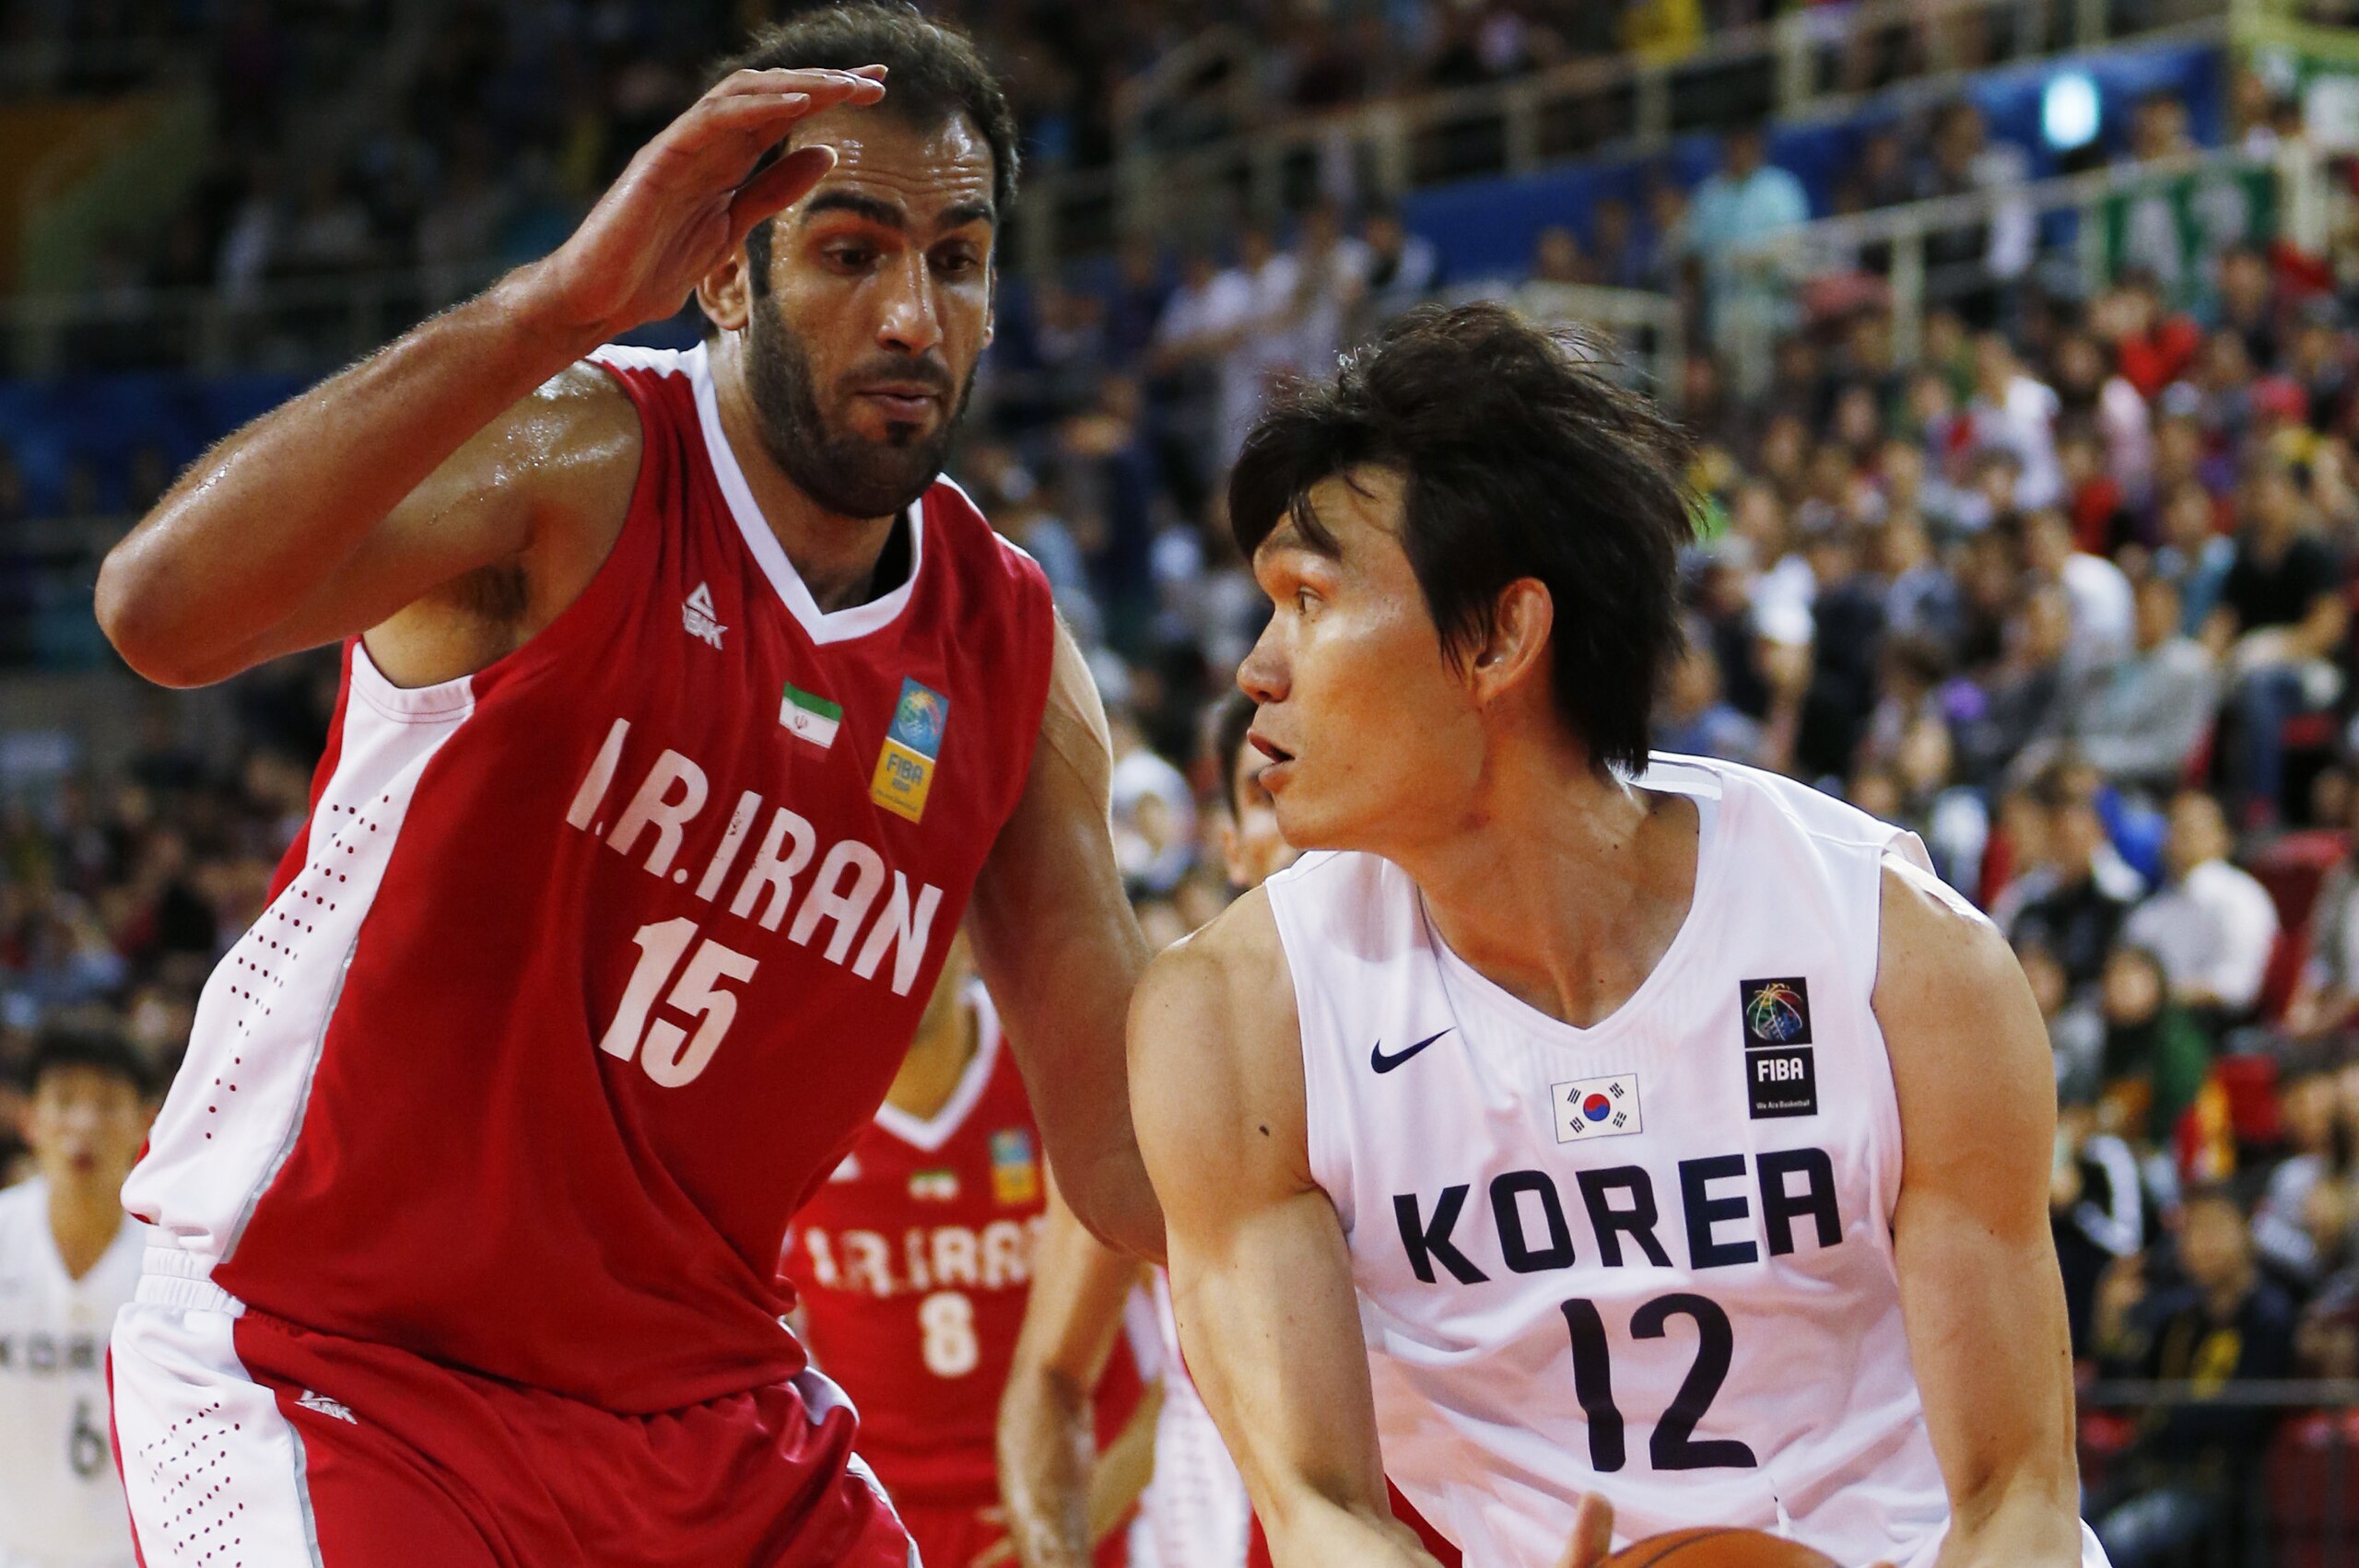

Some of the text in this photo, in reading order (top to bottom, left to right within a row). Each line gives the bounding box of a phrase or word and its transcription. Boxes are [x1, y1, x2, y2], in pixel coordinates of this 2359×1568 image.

[886, 753, 923, 786] FIBA
[599, 917, 759, 1088] 15
[1757, 1058, 1804, 1082] FIBA
[1392, 1147, 1844, 1285] KOREA
[919, 1291, 979, 1377] 8
[1560, 1293, 1758, 1472] 12
[70, 1399, 109, 1480] 6
